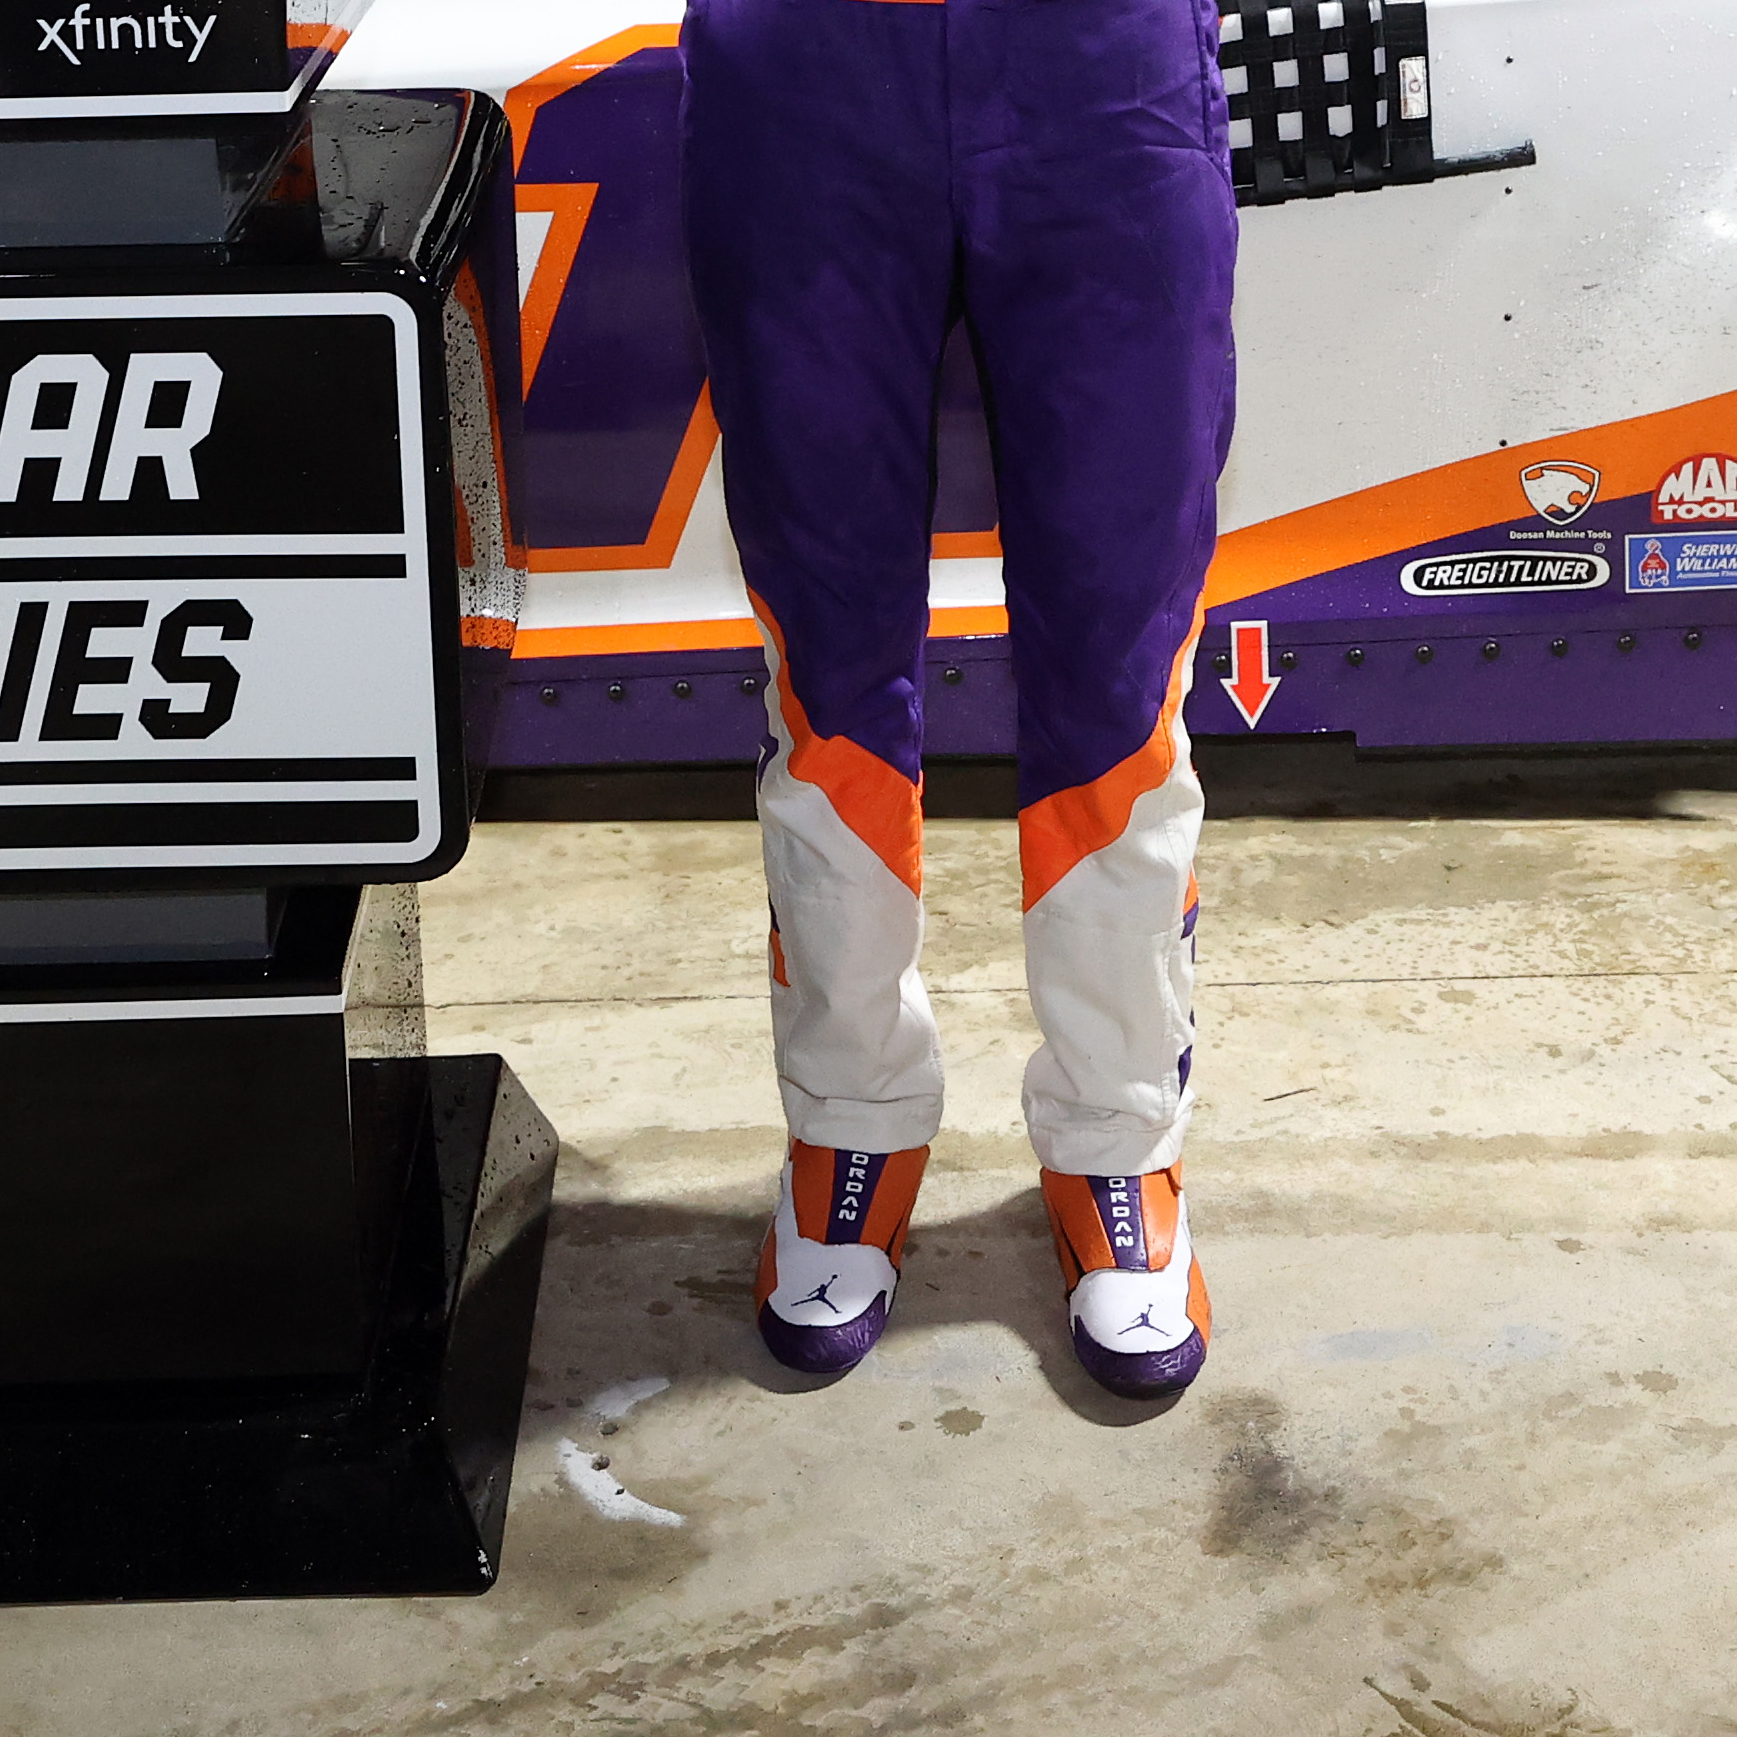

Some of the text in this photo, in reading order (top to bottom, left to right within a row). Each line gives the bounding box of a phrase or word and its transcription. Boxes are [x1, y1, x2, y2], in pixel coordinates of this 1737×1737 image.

[37, 4, 216, 65] xfinity
[1509, 529, 1612, 540] Doosan Machine Tools
[1421, 559, 1590, 587] FREIGHTLINER
[838, 1152, 870, 1222] ORDAN
[1107, 1177, 1136, 1248] ORDAN
